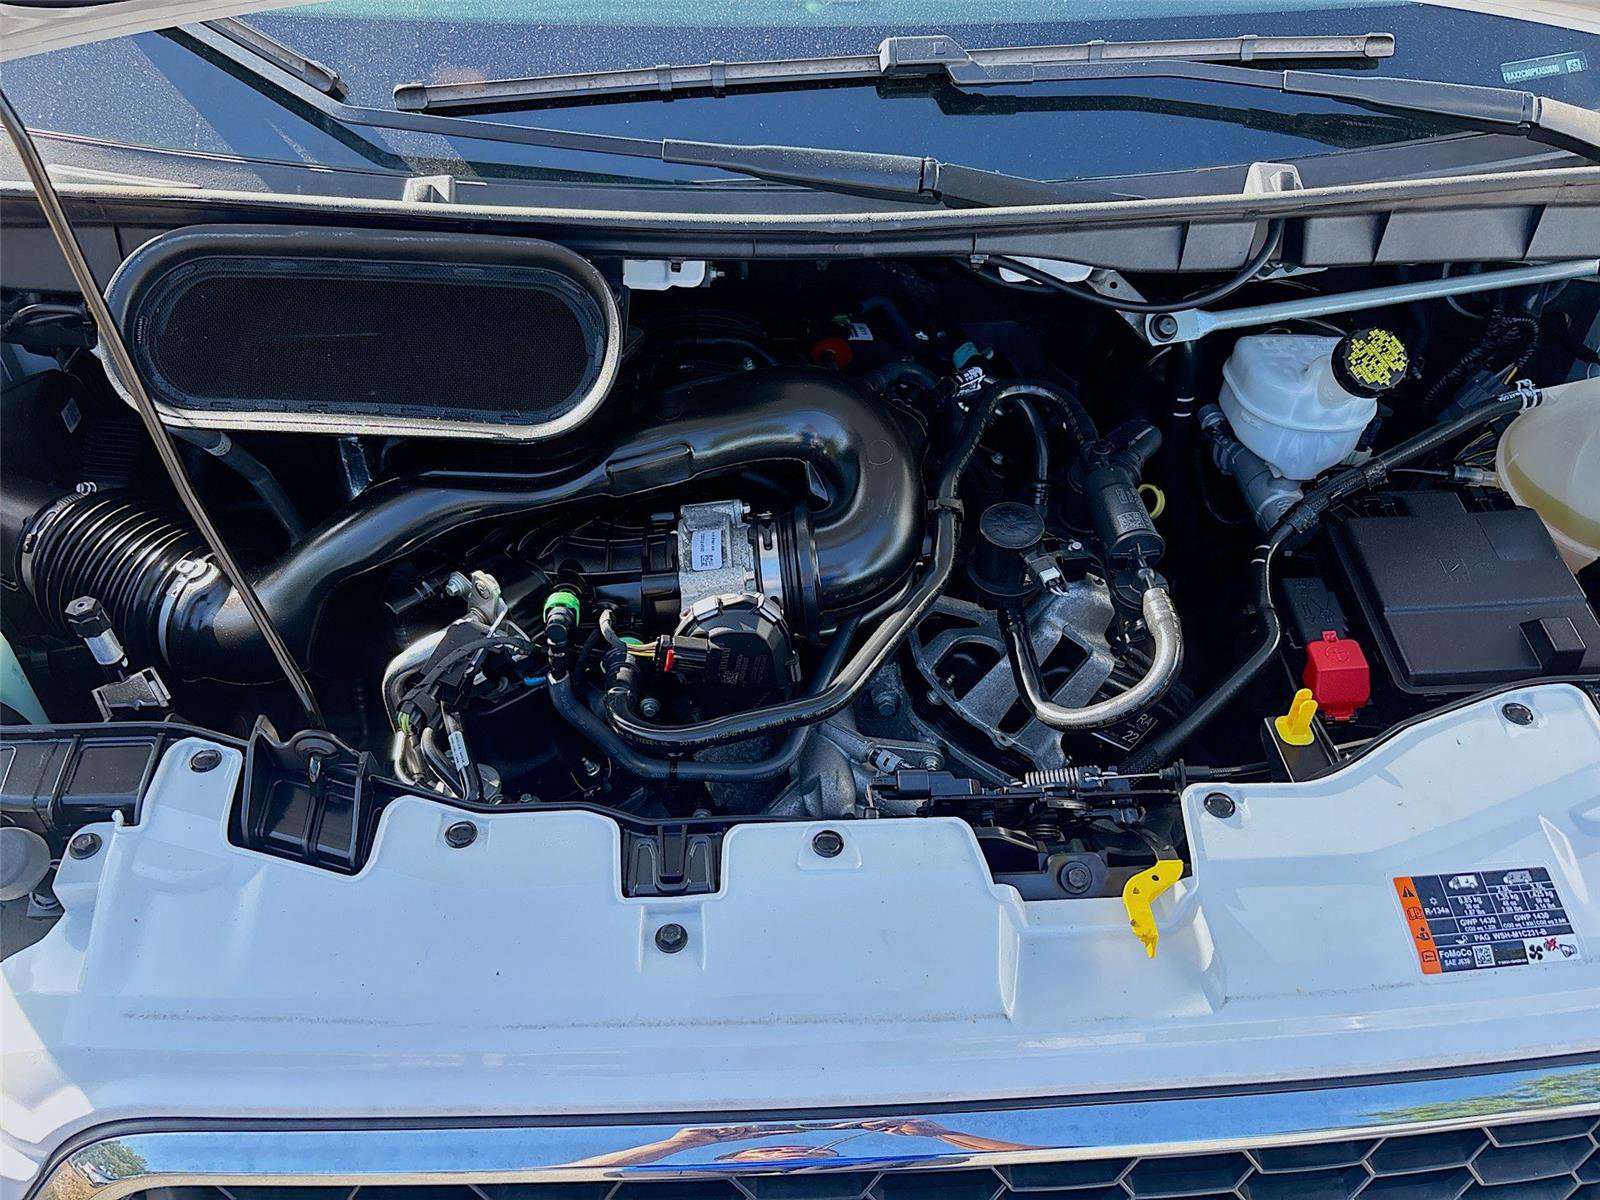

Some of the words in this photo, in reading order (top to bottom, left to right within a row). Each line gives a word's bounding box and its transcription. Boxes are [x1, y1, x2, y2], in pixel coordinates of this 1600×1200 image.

[1424, 906, 1450, 916] R-134a
[1459, 918, 1478, 927] GWP
[1479, 916, 1496, 925] 1430
[1513, 914, 1532, 922] GWP
[1532, 912, 1550, 920] 1430
[1474, 933, 1490, 942] PAG
[1439, 948, 1472, 959] FoMoCo
